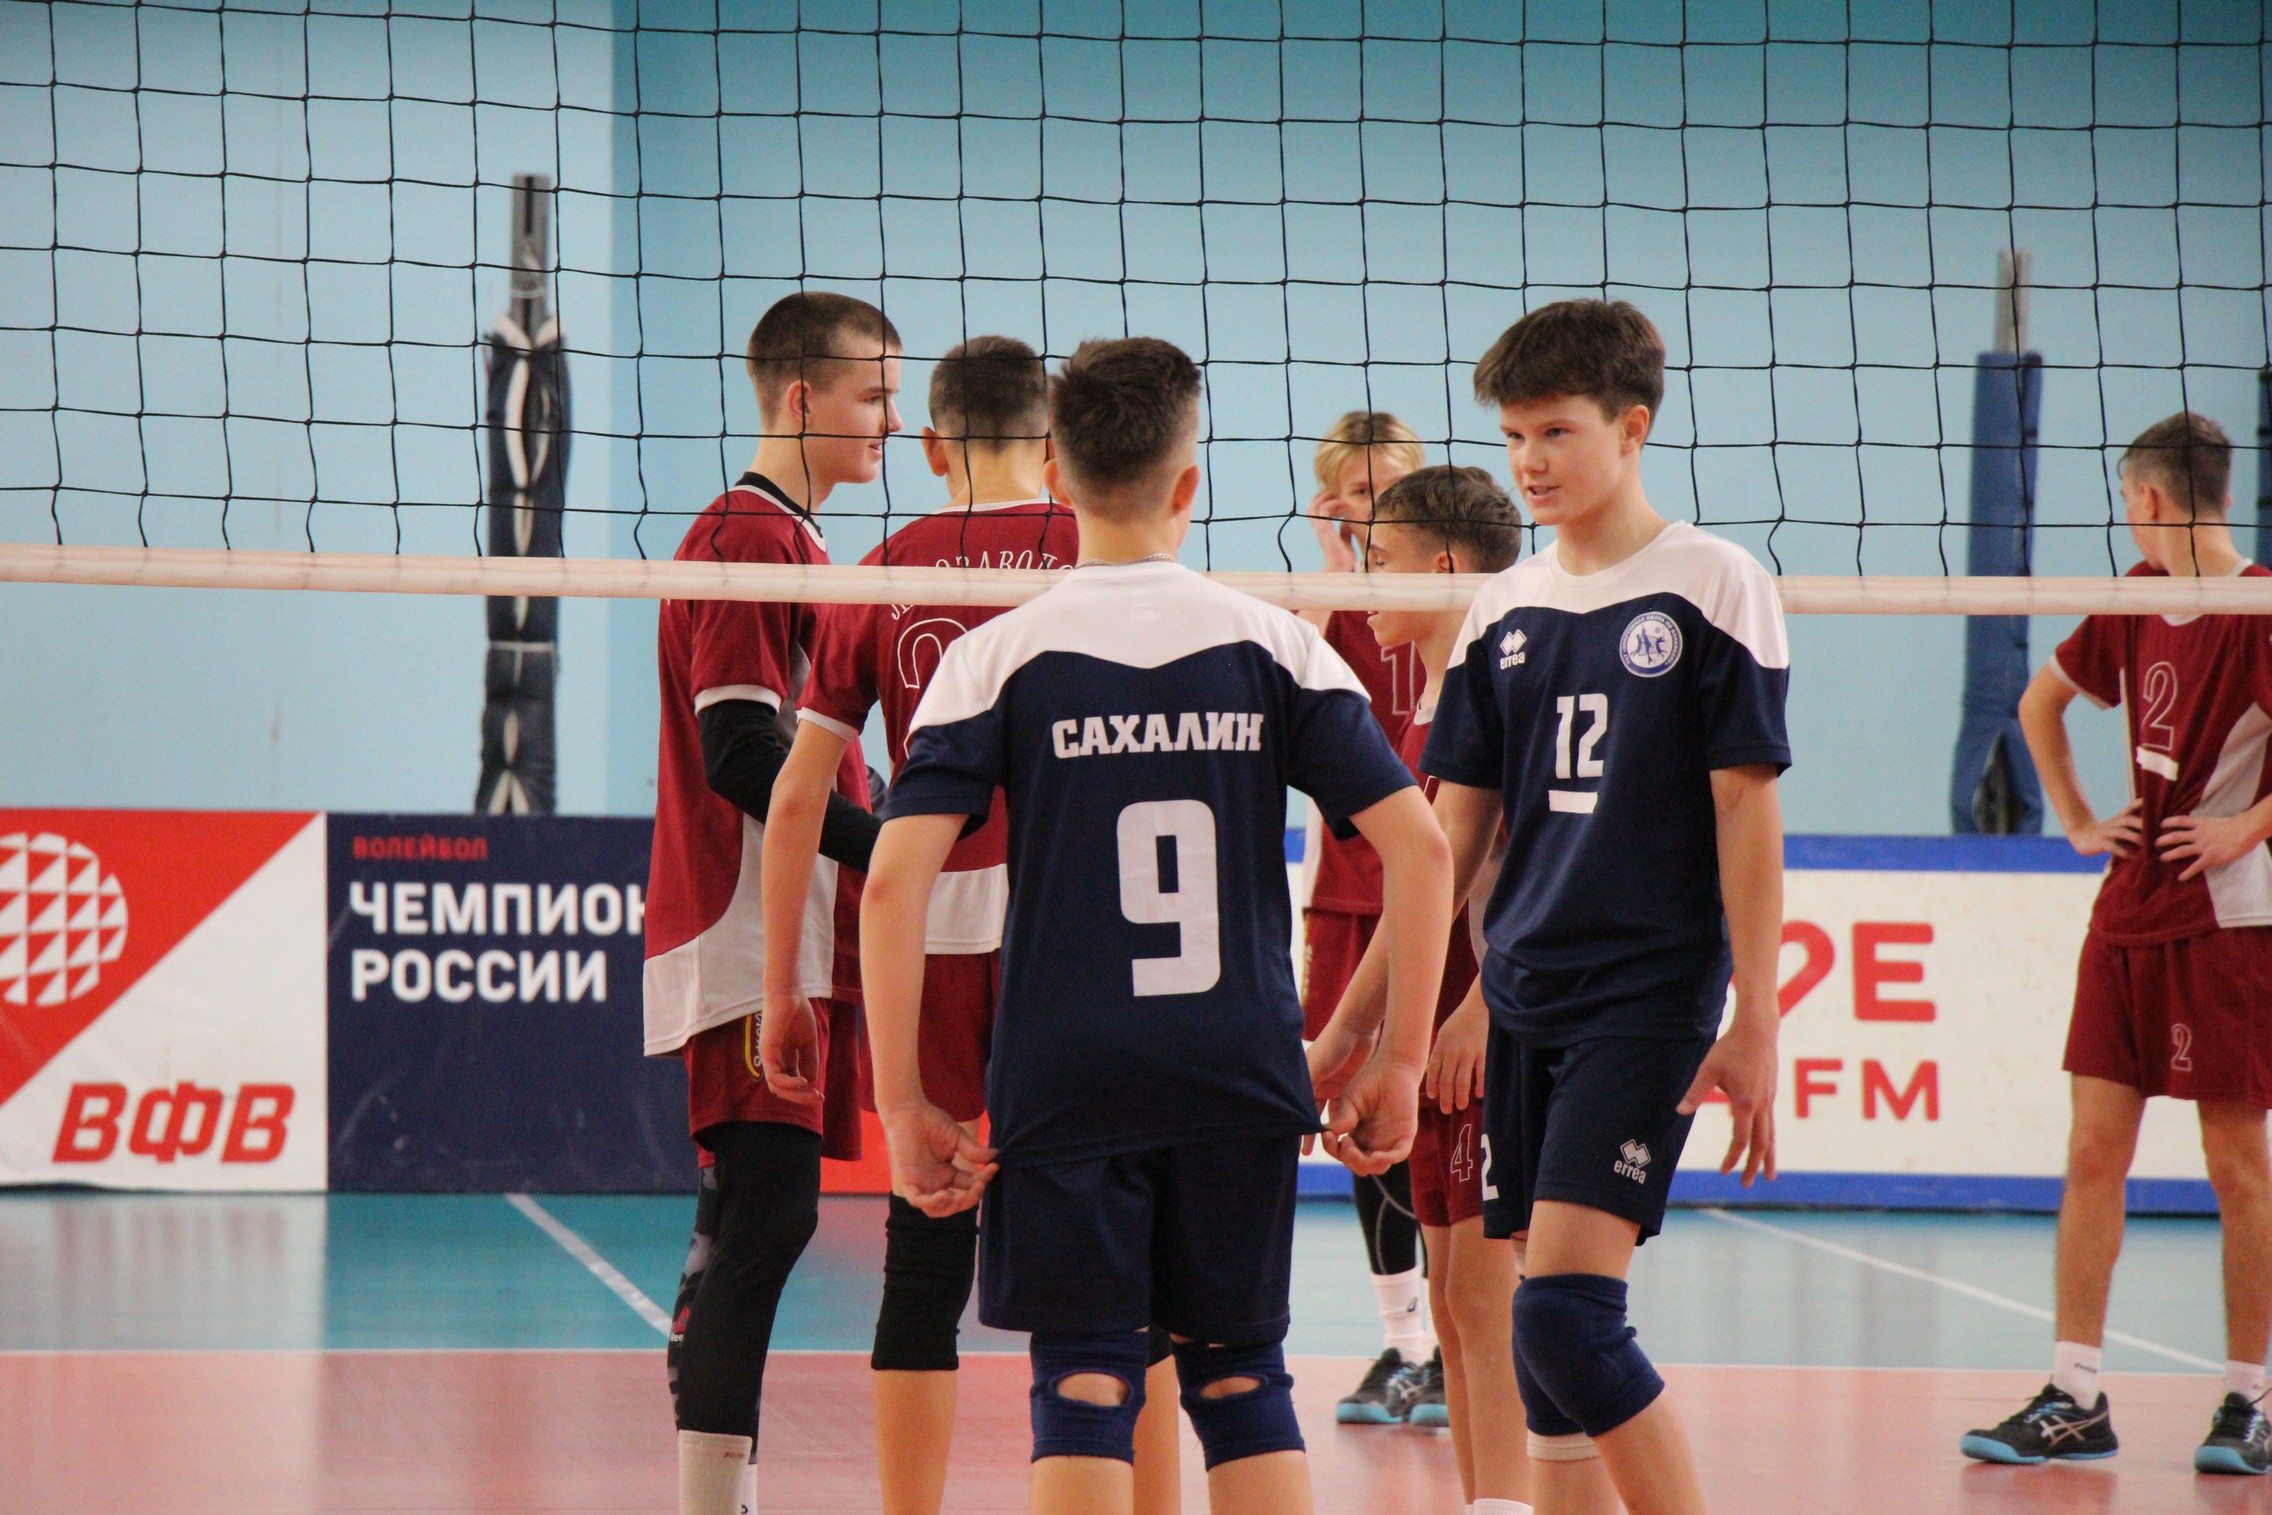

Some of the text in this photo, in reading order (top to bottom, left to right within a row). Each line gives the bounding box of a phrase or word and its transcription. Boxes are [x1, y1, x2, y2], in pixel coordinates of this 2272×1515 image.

[1052, 712, 1264, 759] САХАЛИН
[1556, 693, 1608, 779] 12
[2143, 661, 2178, 751] 2
[353, 834, 488, 860] ВОЛЕЙБОЛ
[1116, 799, 1221, 997] 9
[351, 949, 608, 1002] РОССИИ
[2171, 1023, 2192, 1071] 2
[1794, 1058, 1939, 1122] FM
[53, 1081, 295, 1163] ВФВ
[1450, 1123, 1473, 1182] 4
